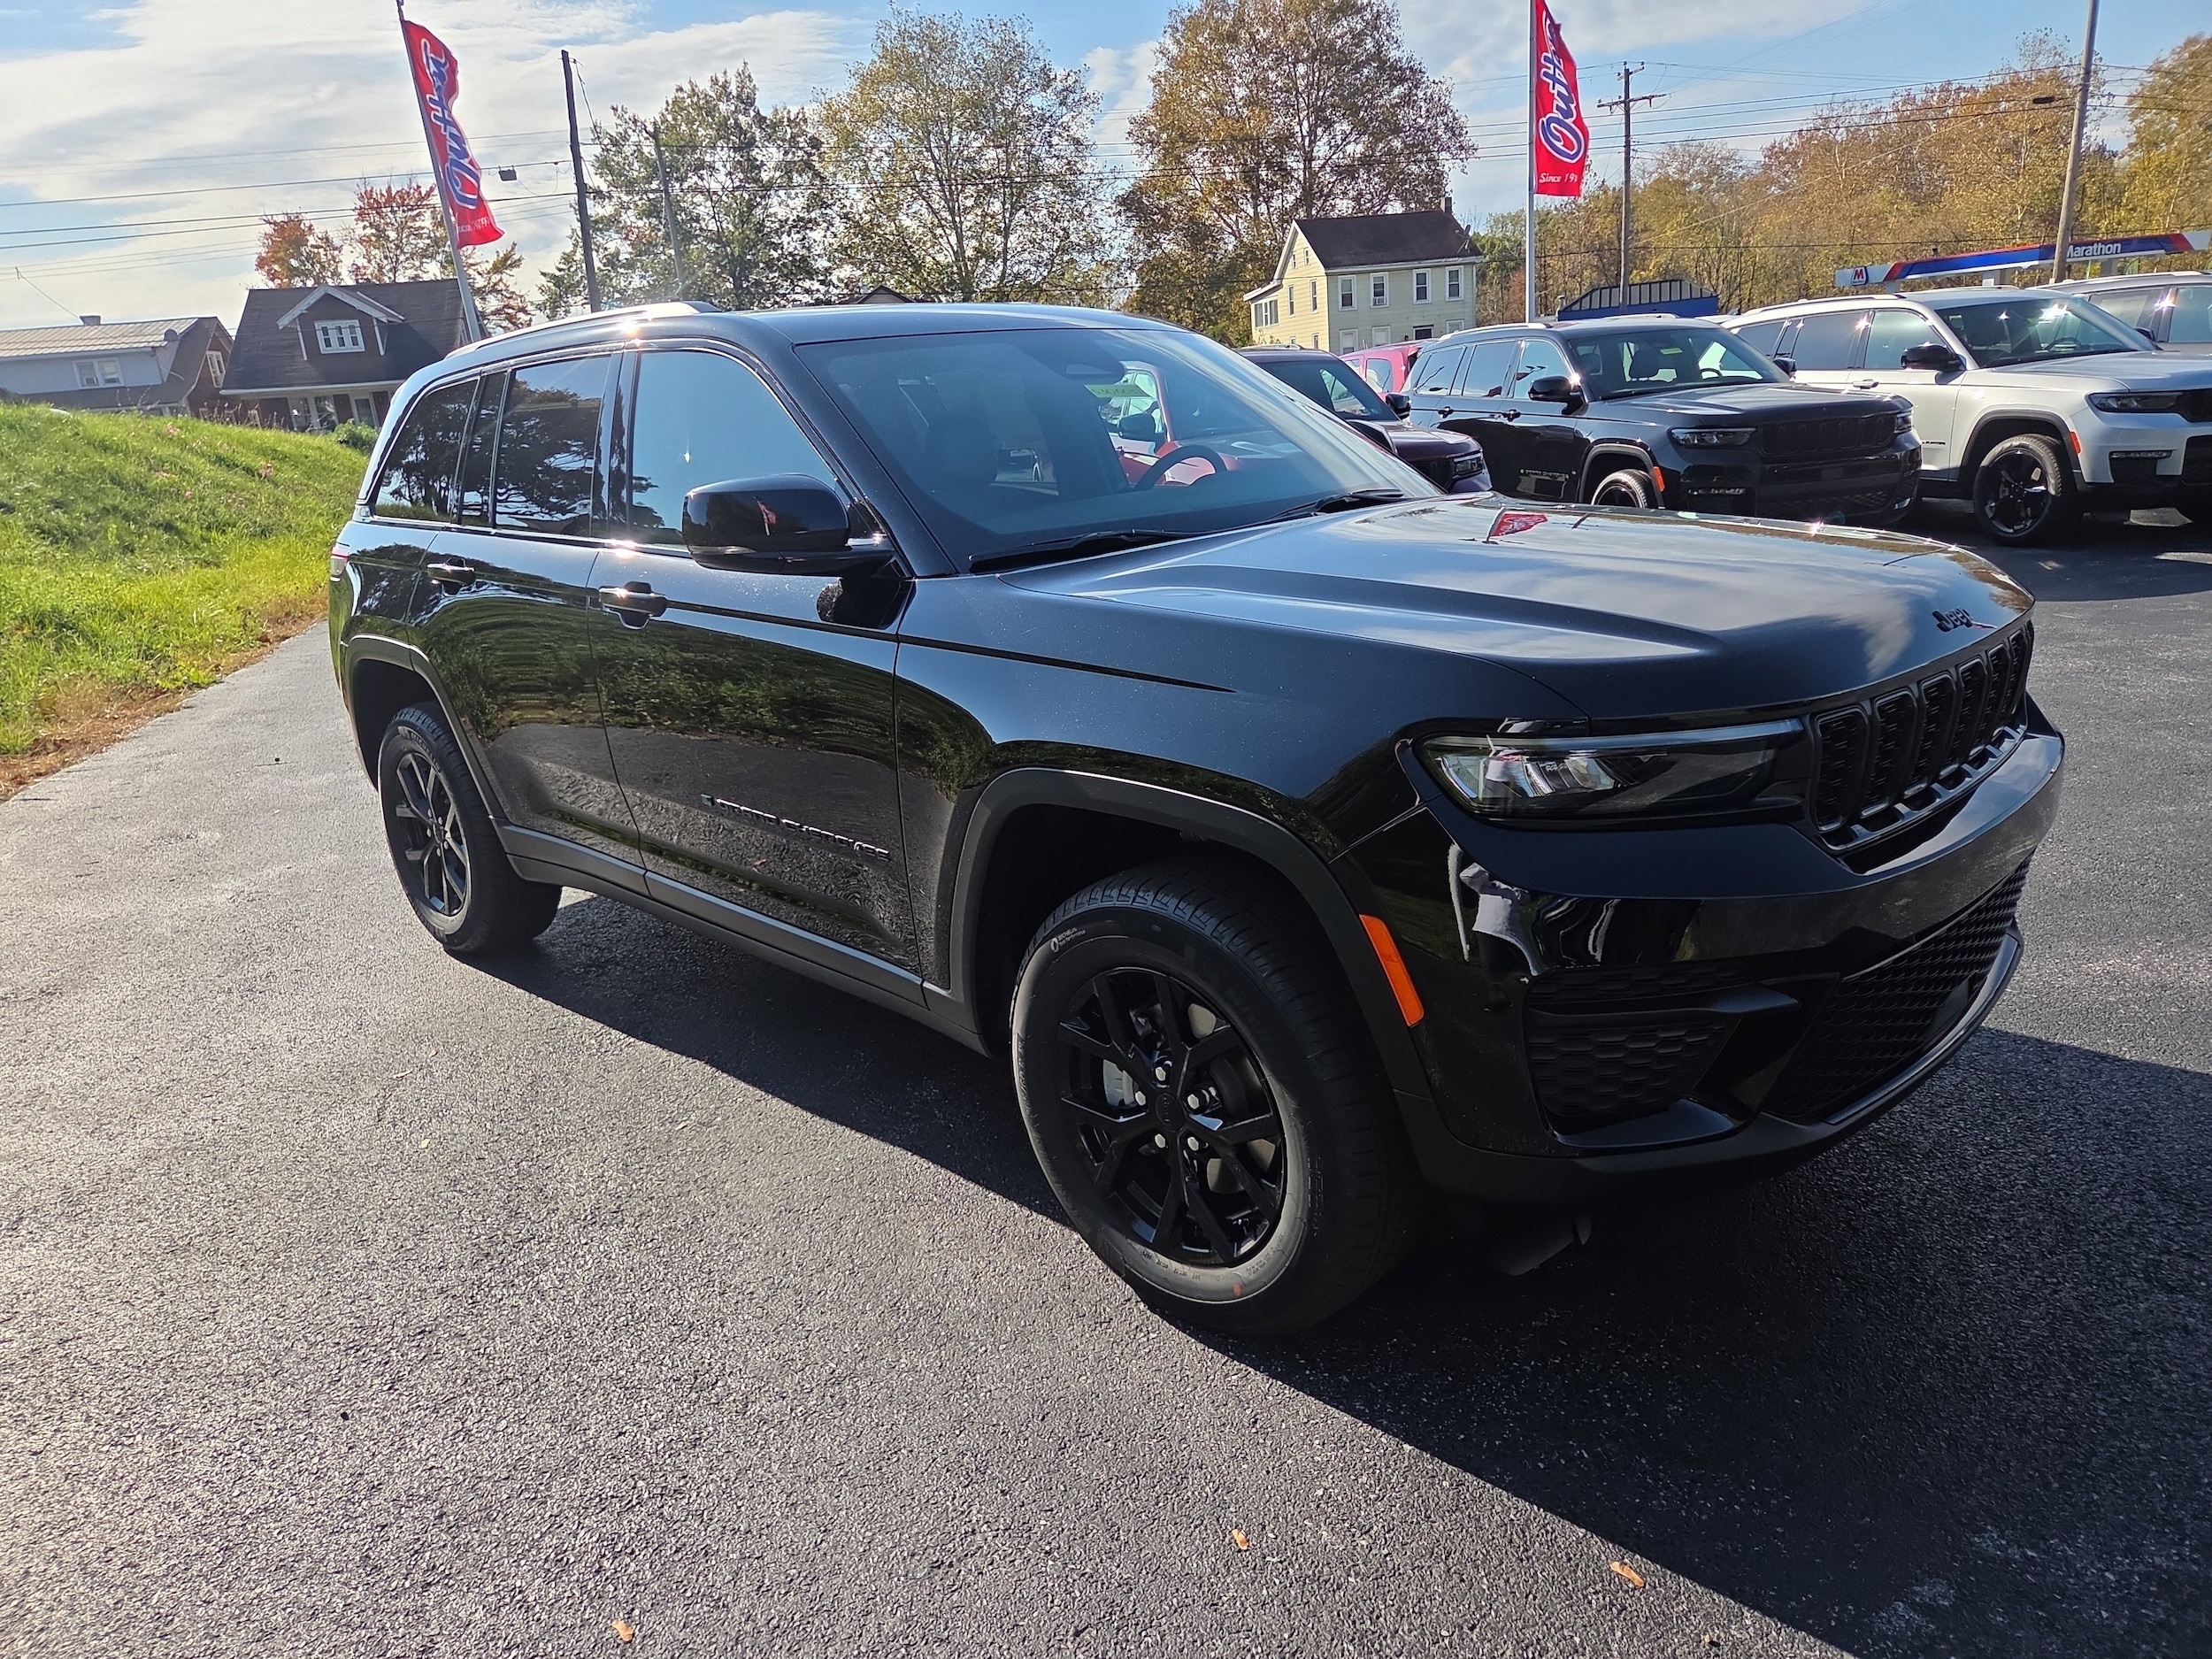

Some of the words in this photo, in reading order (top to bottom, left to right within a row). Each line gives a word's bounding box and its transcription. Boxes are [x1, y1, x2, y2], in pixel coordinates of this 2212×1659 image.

[1539, 9, 1586, 164] Outt
[1539, 172, 1562, 183] Since
[1932, 607, 1974, 633] Jeep
